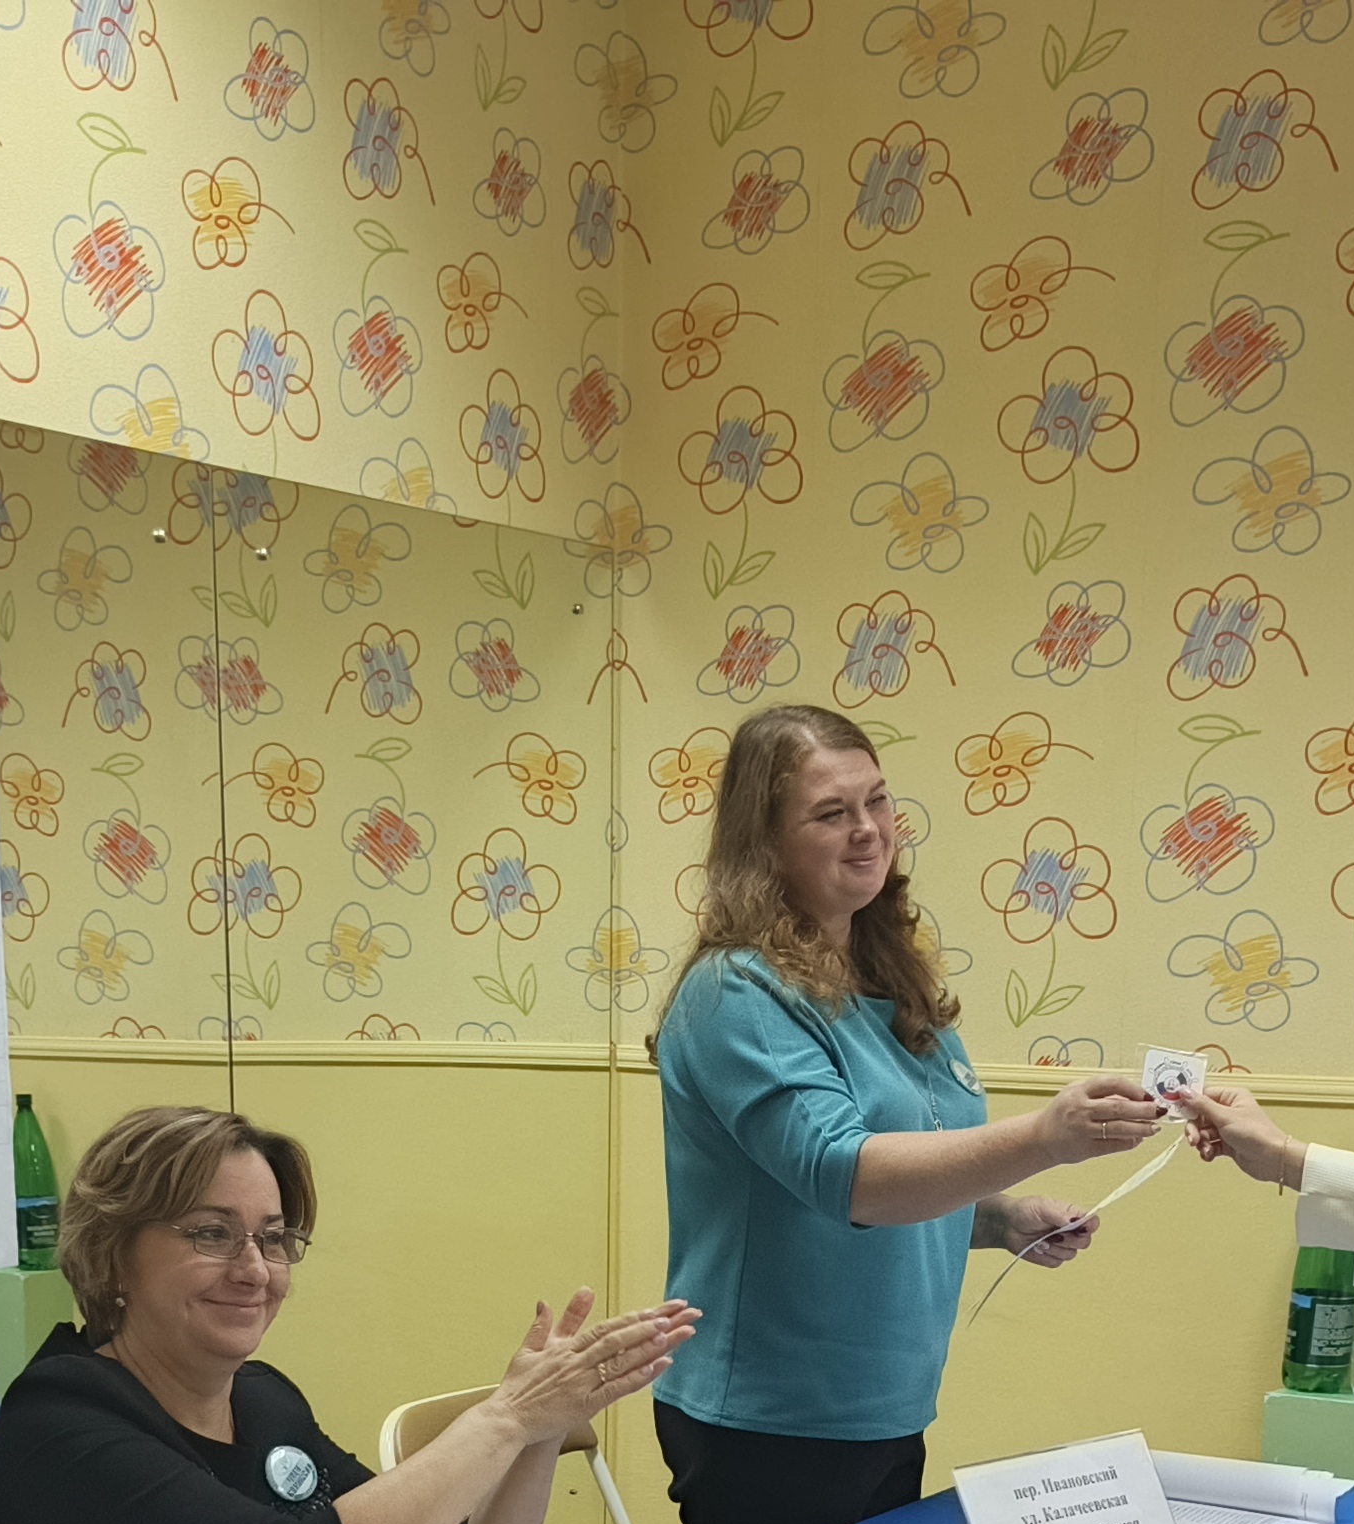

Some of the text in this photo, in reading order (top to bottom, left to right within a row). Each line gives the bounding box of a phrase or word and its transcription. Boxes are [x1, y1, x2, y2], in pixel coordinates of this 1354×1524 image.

[1013, 1465, 1118, 1501] пер. Ивановский
[1044, 1491, 1128, 1523] Калачеевская
